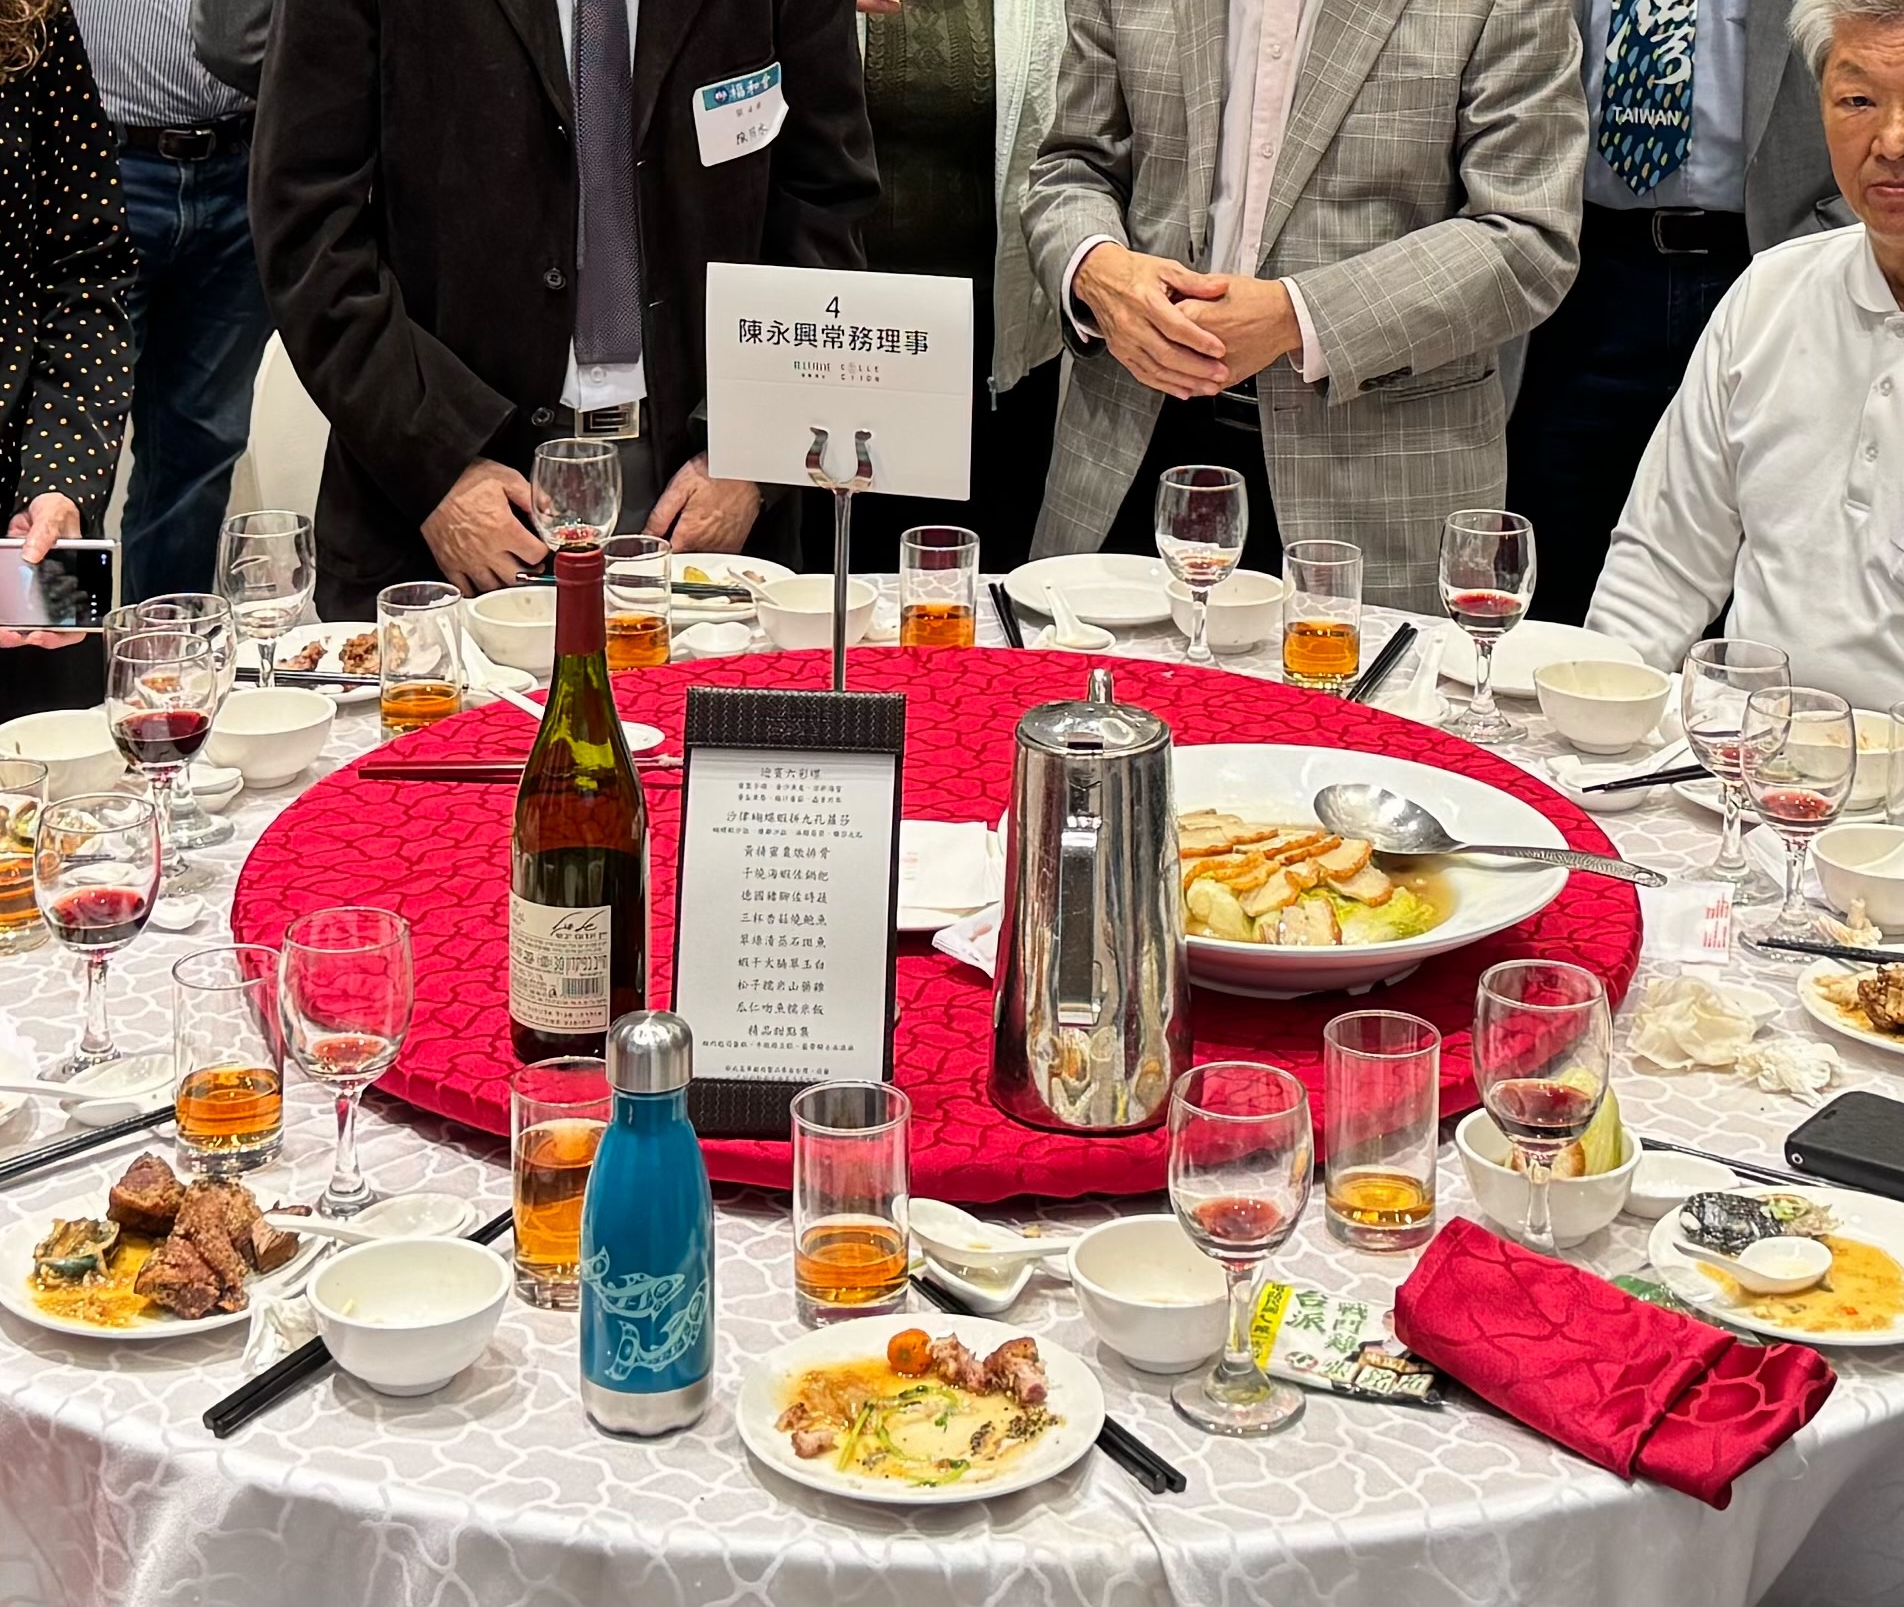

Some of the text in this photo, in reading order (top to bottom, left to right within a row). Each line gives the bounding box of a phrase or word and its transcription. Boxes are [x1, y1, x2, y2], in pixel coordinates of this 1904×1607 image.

[825, 296, 841, 319] 4
[739, 318, 929, 355] 陳永興常務理事
[1286, 1290, 1328, 1333] 台派
